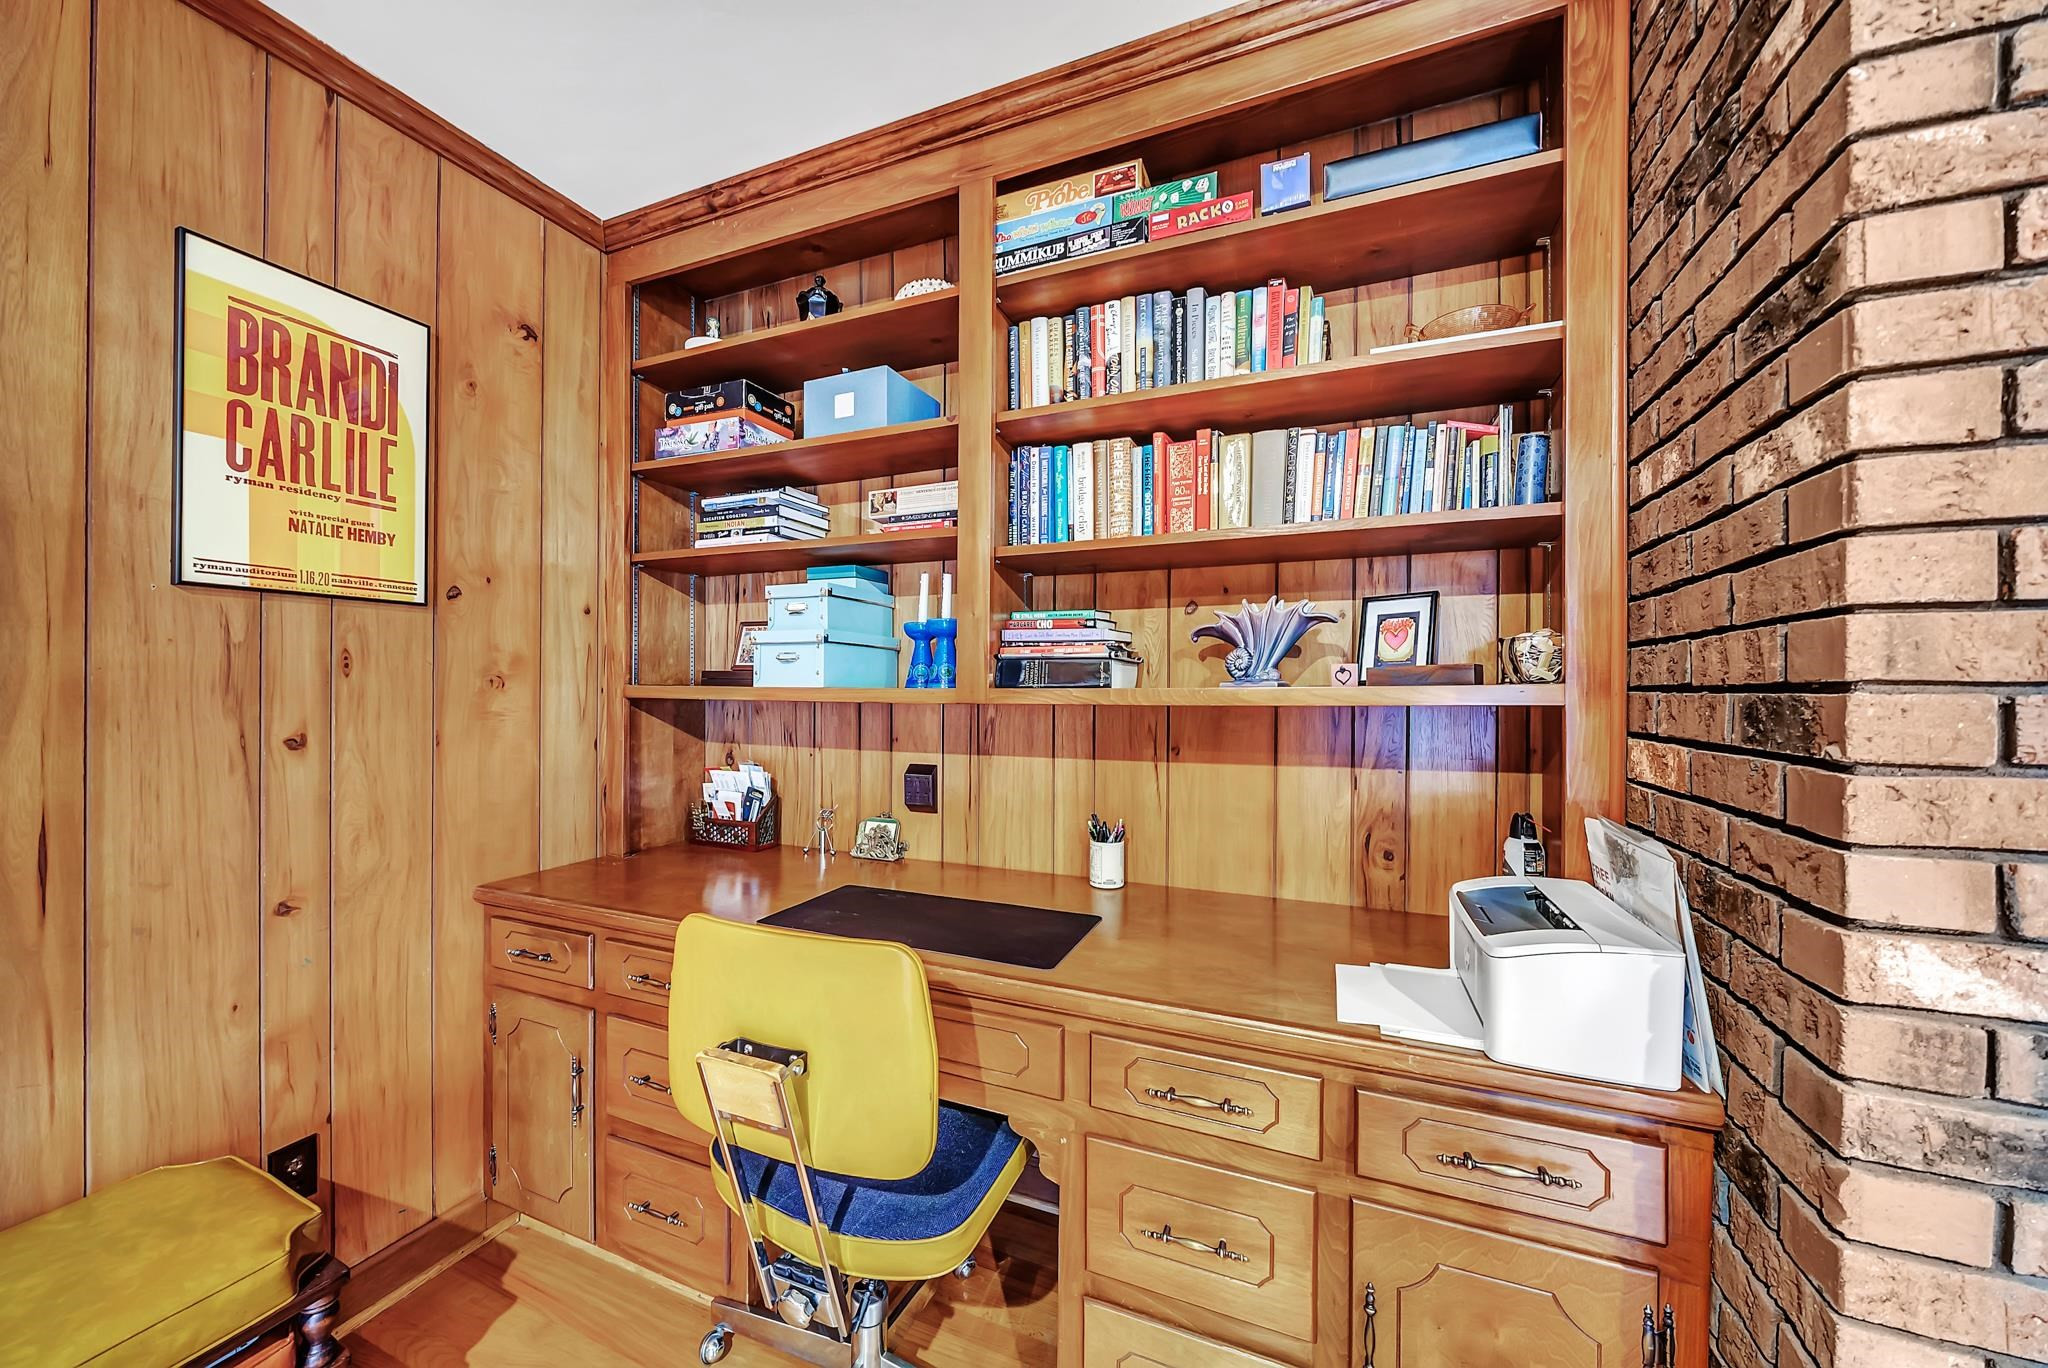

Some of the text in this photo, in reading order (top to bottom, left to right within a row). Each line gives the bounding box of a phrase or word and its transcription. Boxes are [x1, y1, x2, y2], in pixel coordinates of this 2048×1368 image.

[1025, 180, 1090, 213] Probe
[1192, 304, 1199, 312] In
[227, 305, 399, 436] BRANDI
[1110, 355, 1120, 394] JOHN OAT
[226, 398, 397, 502] CARLILE
[1114, 442, 1124, 477] HERE
[225, 474, 341, 503] ryman residency
[1078, 476, 1086, 505] bridge
[1114, 493, 1124, 512] AM
[289, 509, 375, 528] with special guest
[1077, 515, 1087, 535] clay
[1144, 506, 1152, 526] DAYS
[288, 517, 396, 547] NATALIE HEMBY
[193, 562, 298, 579] ryman auditorium
[1037, 620, 1053, 628] CHO
[1592, 863, 1609, 881] FREE
